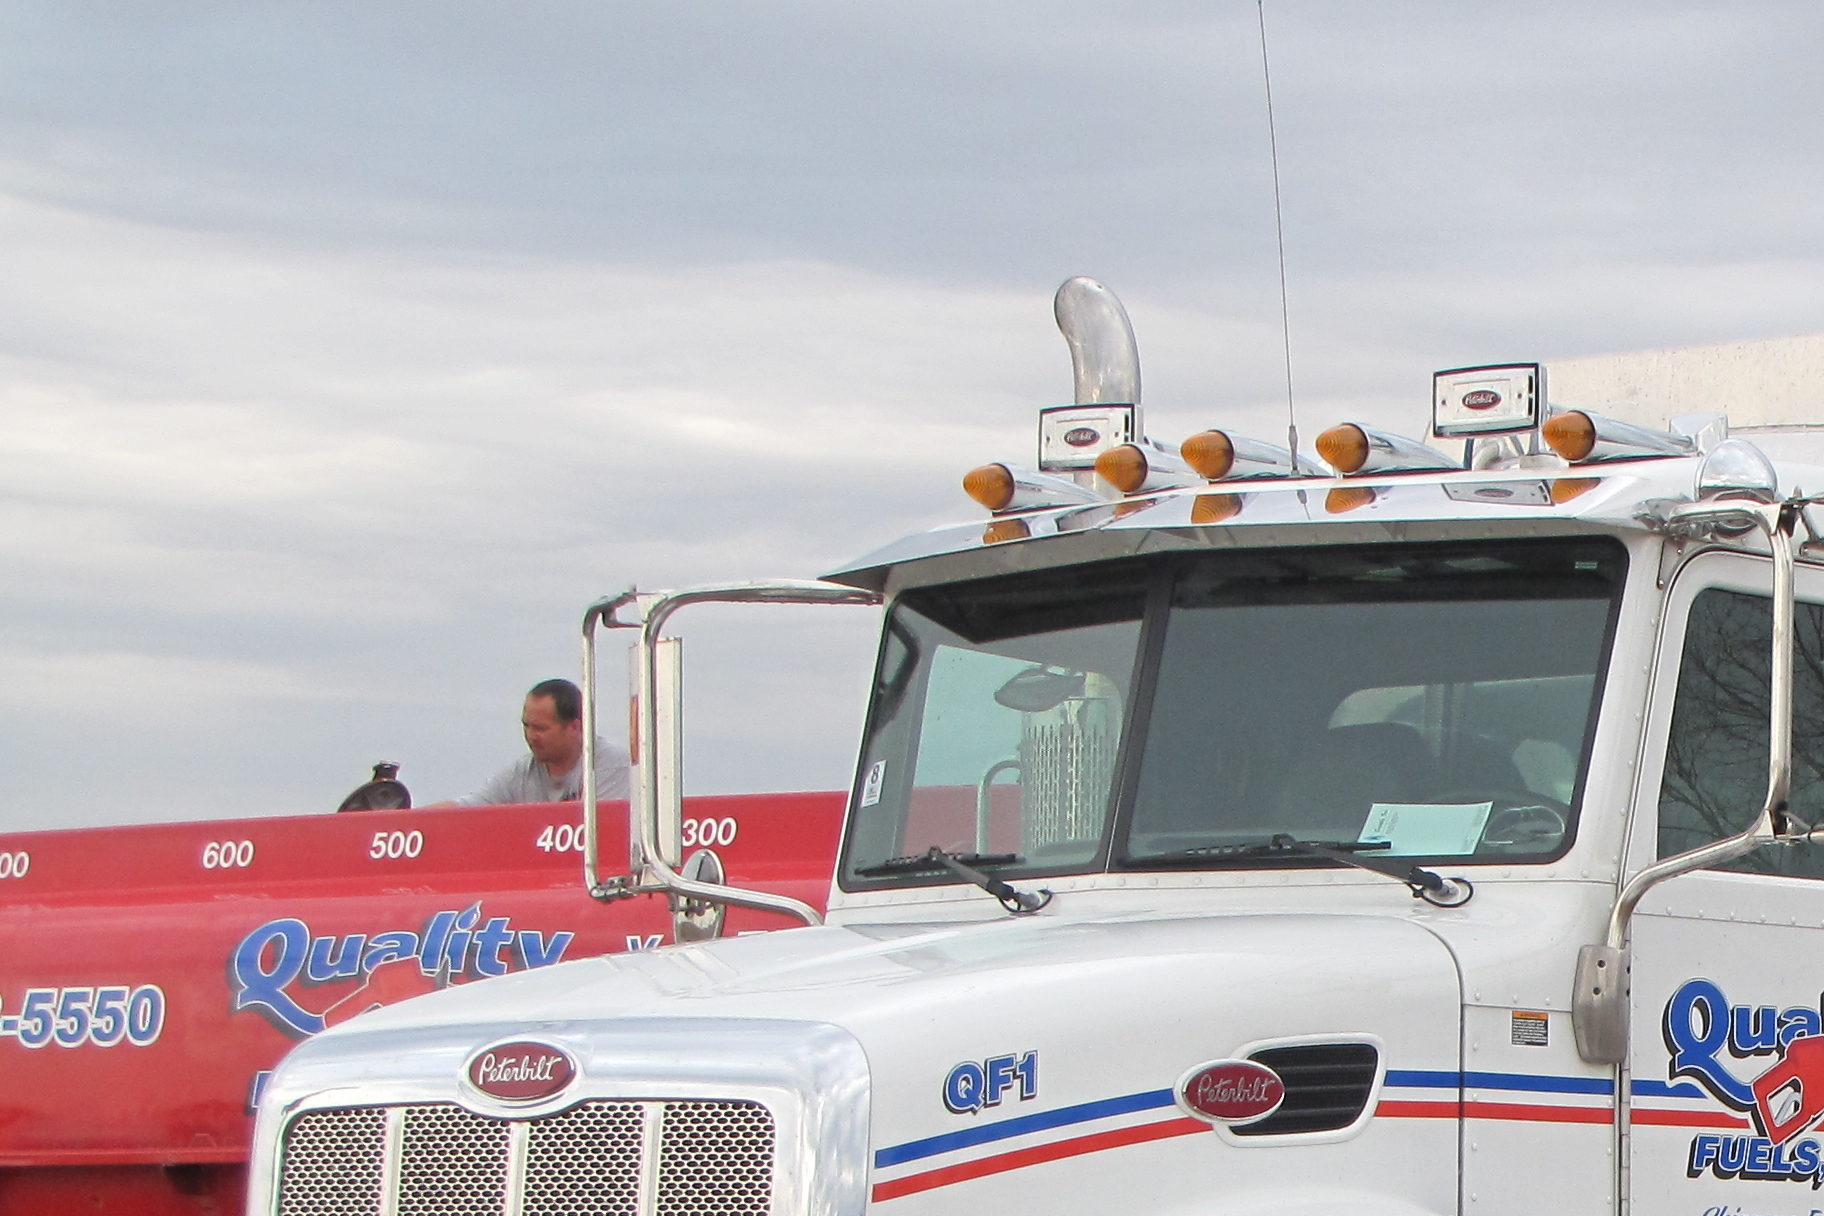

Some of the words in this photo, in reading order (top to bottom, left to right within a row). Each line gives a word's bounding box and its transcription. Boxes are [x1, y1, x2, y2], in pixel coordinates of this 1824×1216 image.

[369, 830, 424, 859] 500
[536, 824, 586, 852] 400
[682, 817, 737, 846] 300
[0, 851, 30, 878] 00
[202, 840, 255, 869] 600
[0, 984, 166, 1049] -5550
[478, 1053, 563, 1085] Peterbilt
[943, 1050, 1038, 1114] QF1
[1197, 1073, 1276, 1106] Peterbilt
